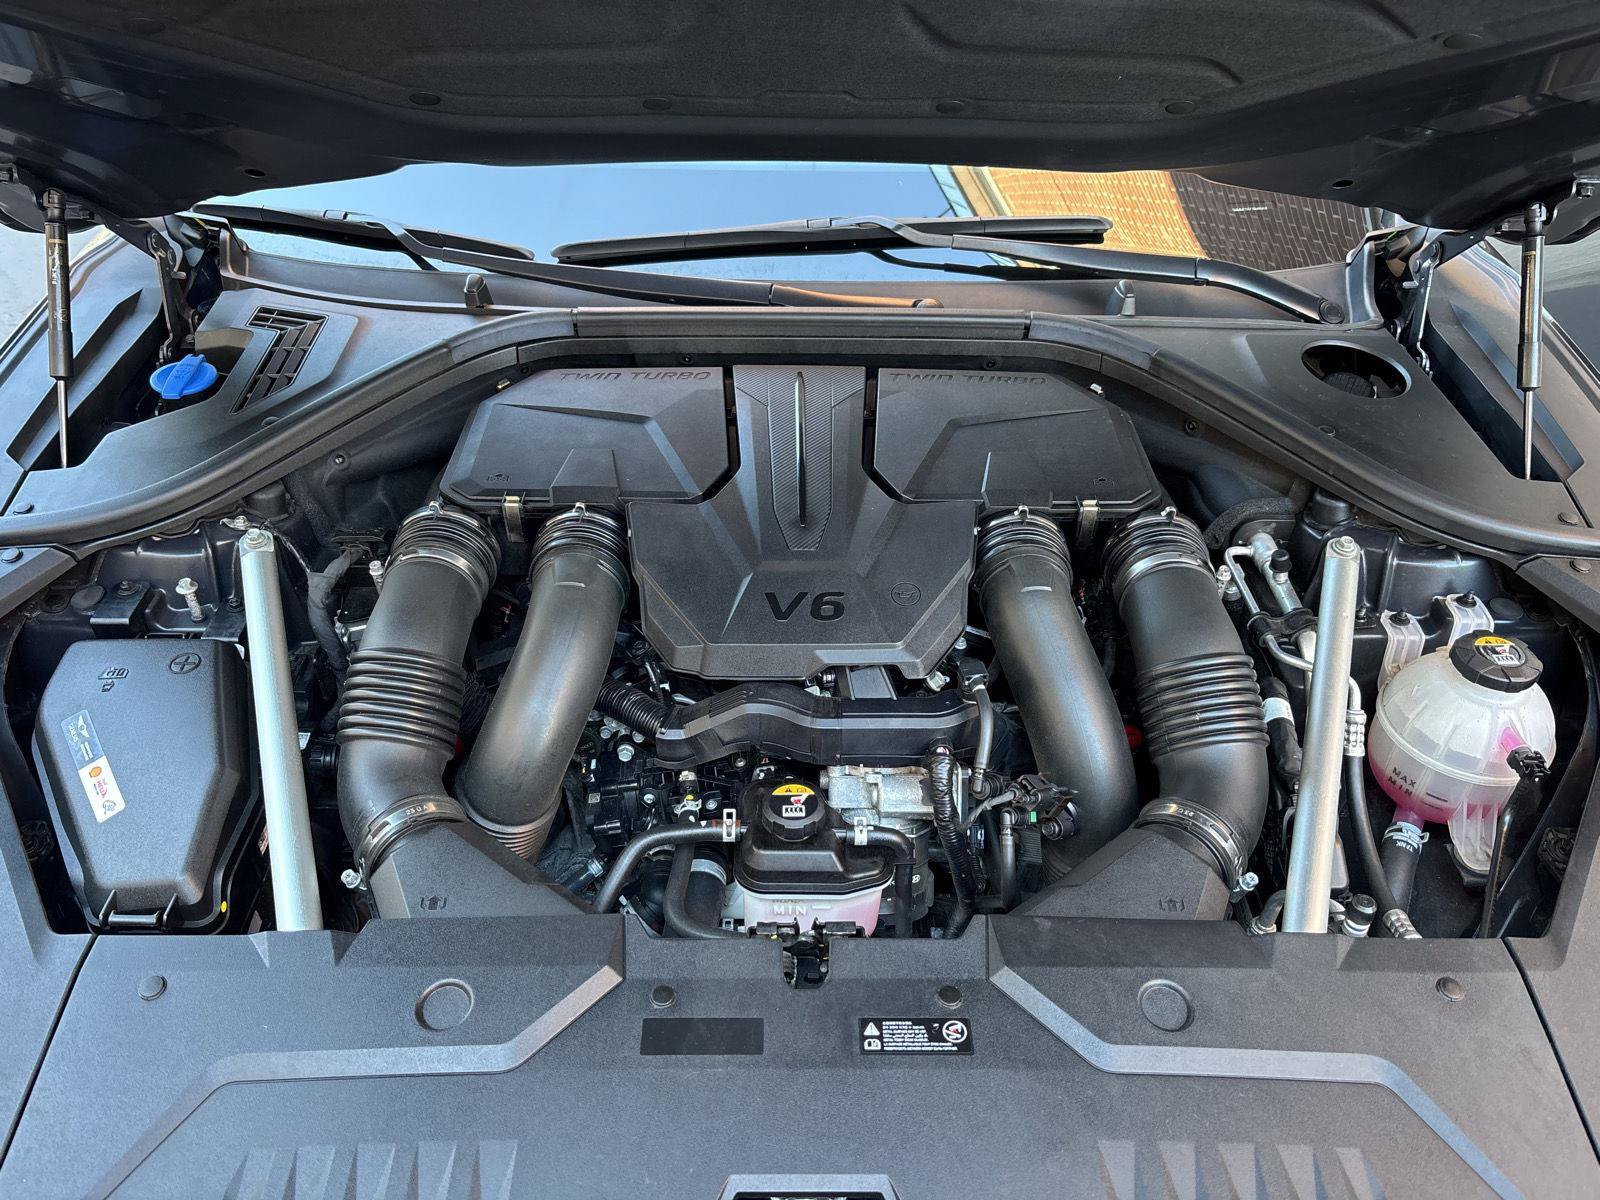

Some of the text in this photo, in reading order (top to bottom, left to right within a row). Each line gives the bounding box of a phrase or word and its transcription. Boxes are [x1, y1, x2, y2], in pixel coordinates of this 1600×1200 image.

[560, 371, 712, 381] TWIN TURBO
[889, 372, 1049, 385] TWIN TURBO
[764, 591, 845, 621] V6
[1388, 775, 1413, 797] MIN
[1392, 767, 1417, 788] MAX
[773, 904, 807, 916] MIN
